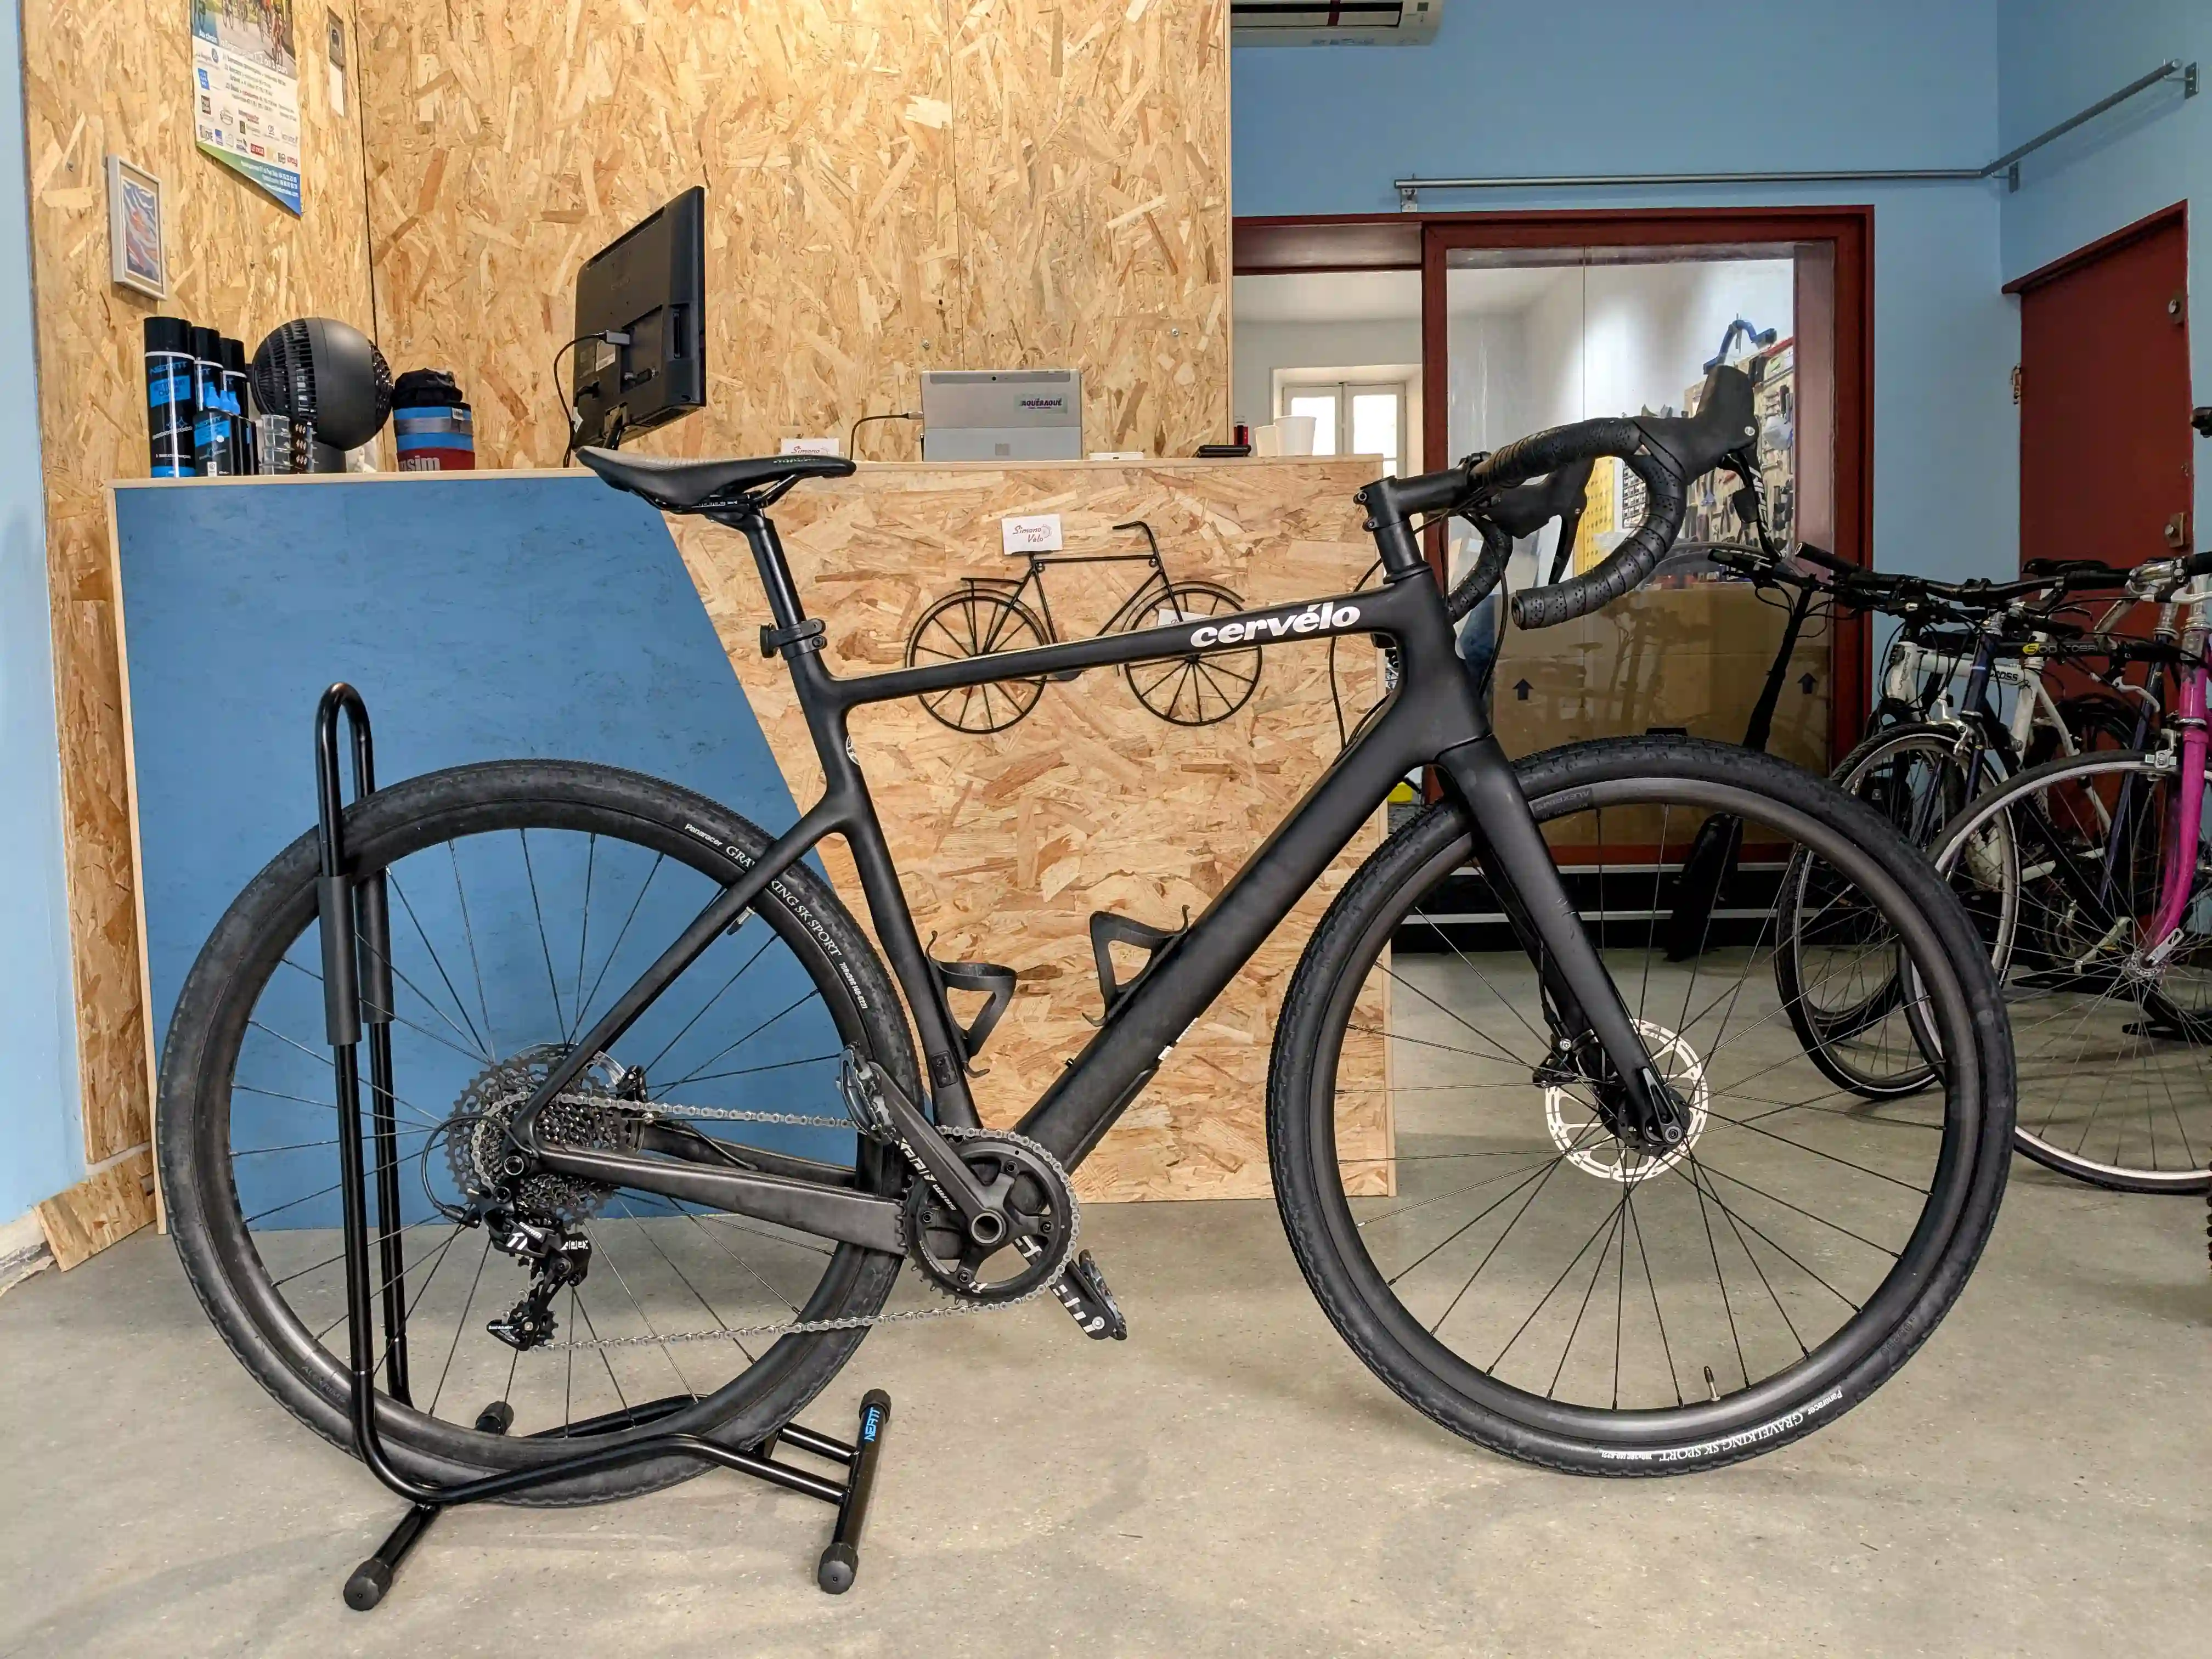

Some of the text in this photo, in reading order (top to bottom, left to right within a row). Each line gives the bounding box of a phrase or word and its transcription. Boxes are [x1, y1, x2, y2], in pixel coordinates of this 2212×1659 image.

[1190, 601, 1361, 647] cervélo
[684, 823, 724, 848] Panaracer
[794, 905, 812, 922] SK
[807, 919, 843, 957] SPORT
[1807, 1389, 1843, 1415] Panaracer
[1722, 1411, 1804, 1453] GRAVELKING
[1659, 1444, 1702, 1462] SPORT
[1703, 1443, 1721, 1457] SK
